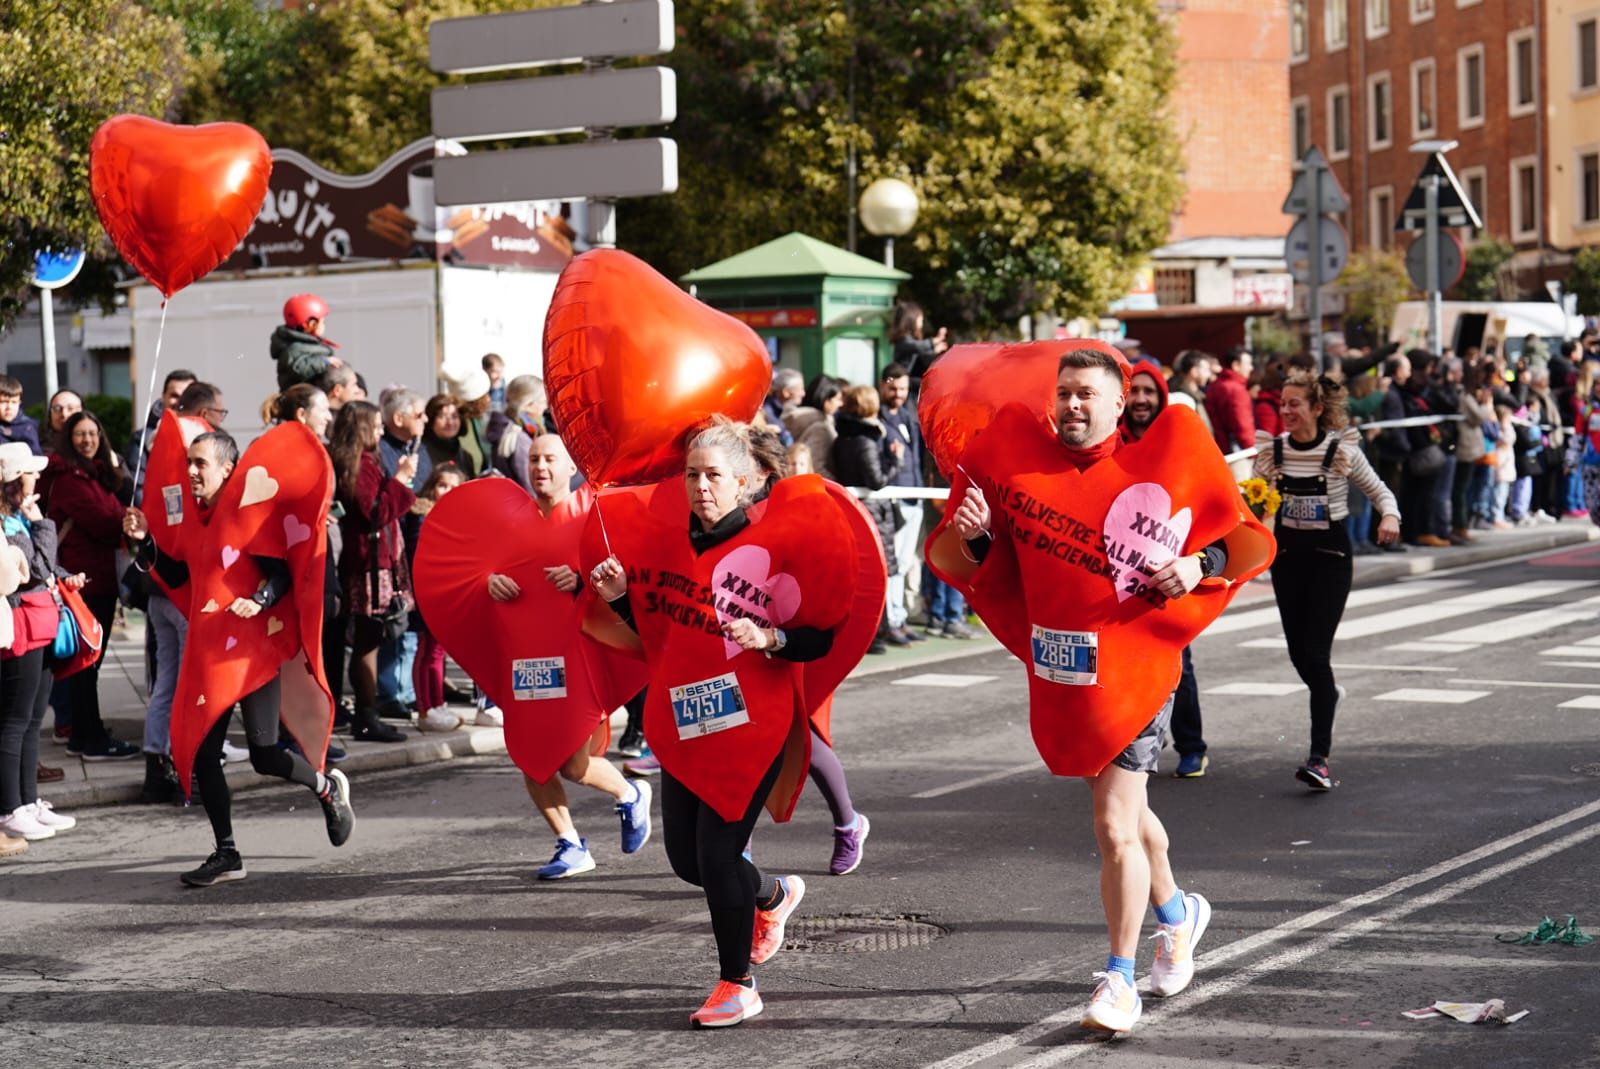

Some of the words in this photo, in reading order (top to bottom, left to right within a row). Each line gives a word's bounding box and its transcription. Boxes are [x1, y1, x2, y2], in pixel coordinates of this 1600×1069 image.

[1009, 491, 1097, 545] SILVESTRE
[1129, 511, 1181, 556] XXXIX
[1035, 532, 1122, 583] DICIEMBRE
[1045, 631, 1090, 645] SETEL
[525, 660, 559, 669] SETEL
[1040, 641, 1076, 668] 2861
[518, 668, 553, 687] 2863
[686, 678, 732, 697] SETEL
[682, 690, 723, 720] 4757
